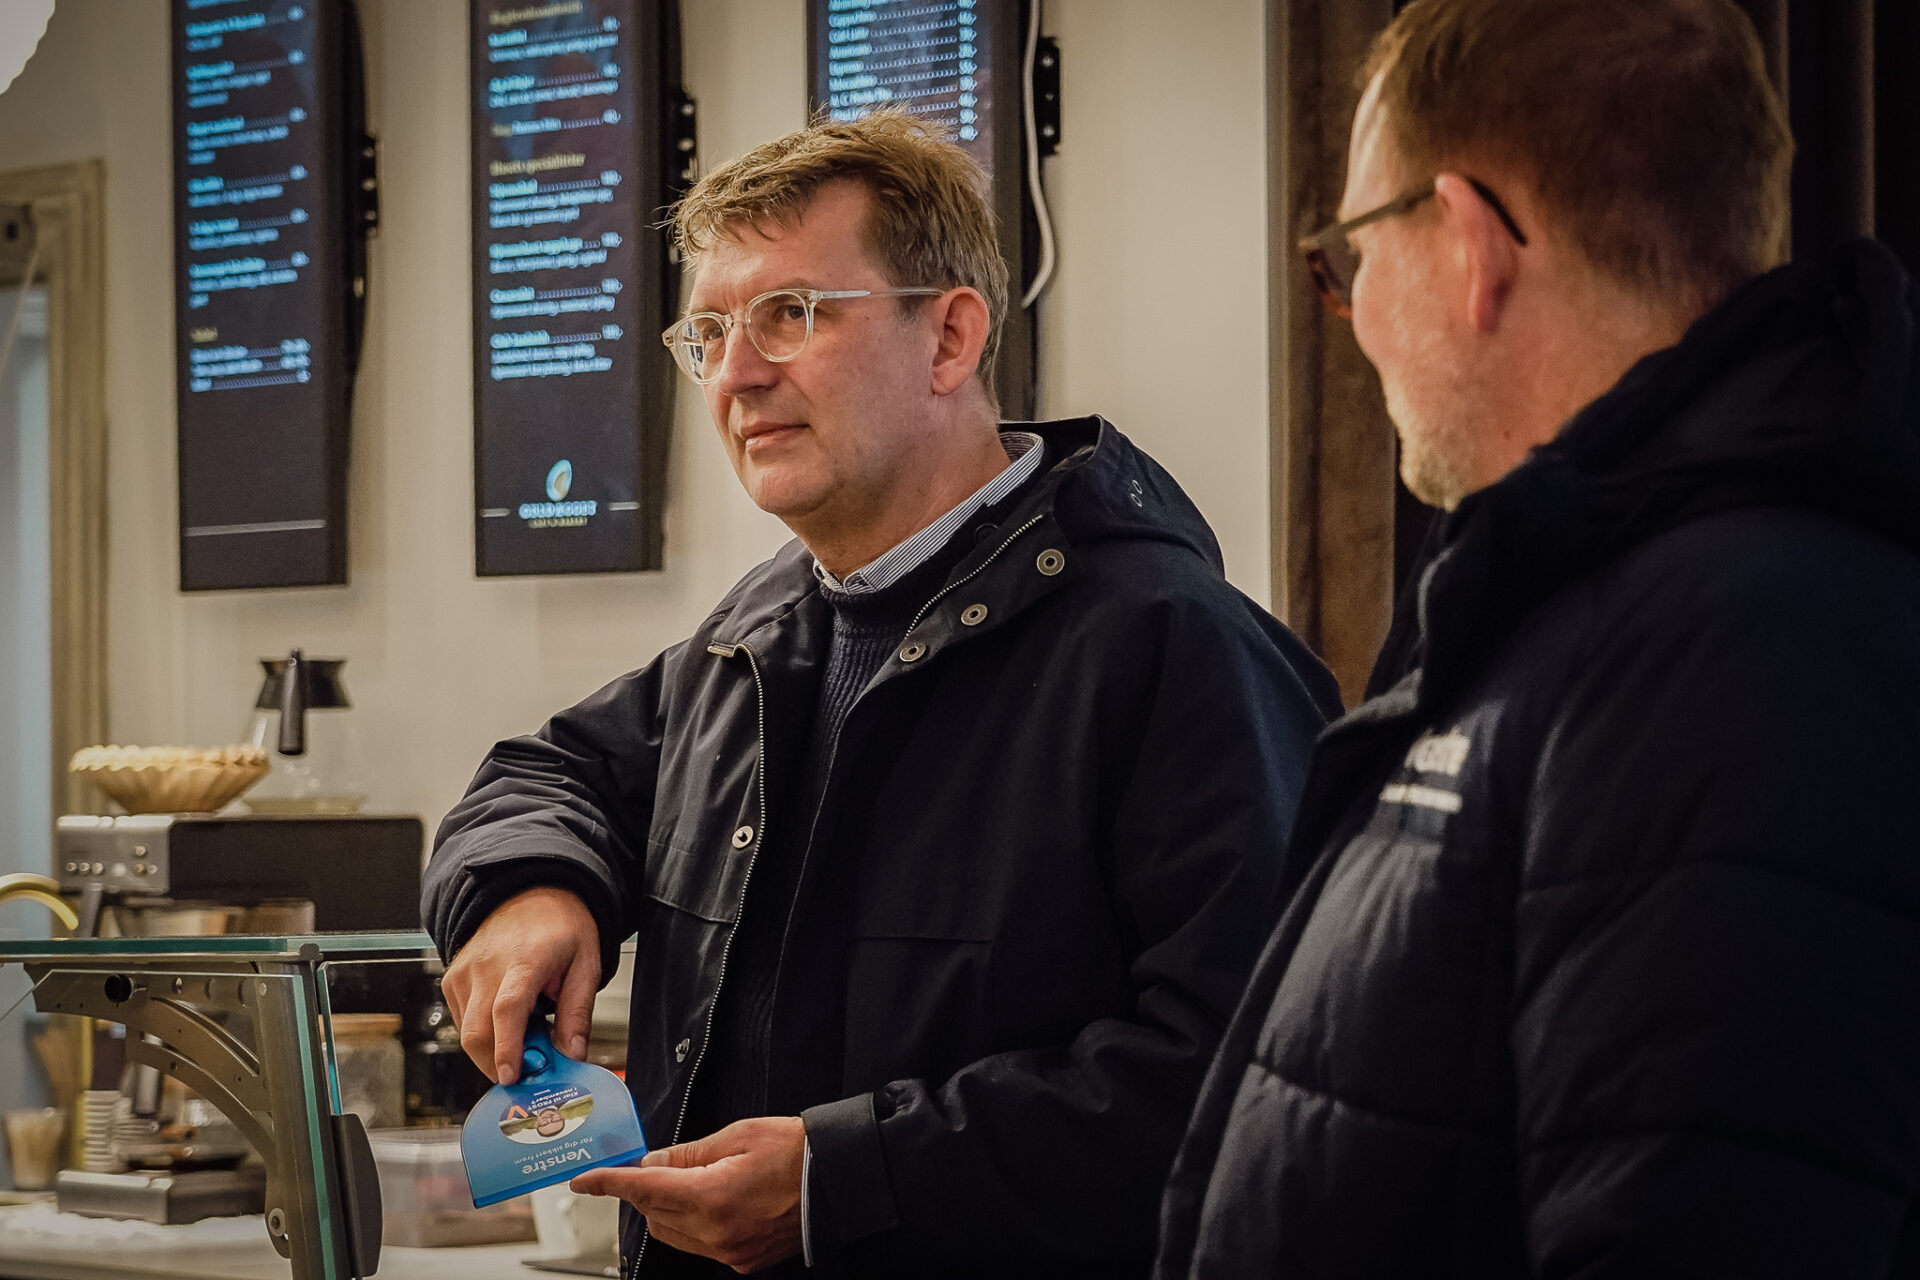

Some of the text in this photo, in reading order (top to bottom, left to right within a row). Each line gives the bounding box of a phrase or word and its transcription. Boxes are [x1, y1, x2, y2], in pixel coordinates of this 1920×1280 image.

[562, 1091, 579, 1100] Klar
[526, 1099, 553, 1111] FROST
[506, 1105, 529, 1121] V
[564, 1140, 578, 1149] dig
[535, 1145, 563, 1158] sikkert
[522, 1148, 592, 1175] Venstre
